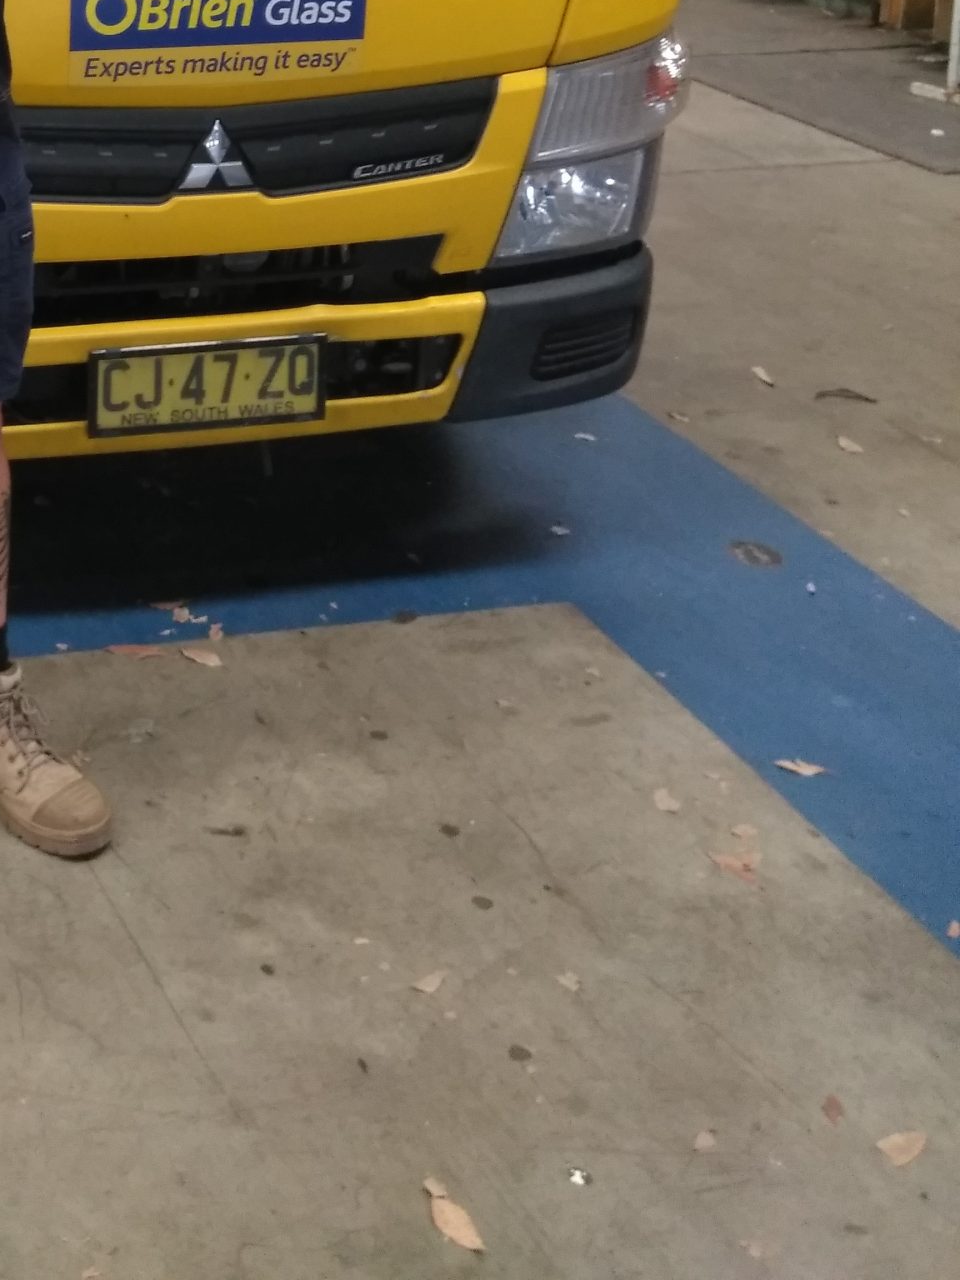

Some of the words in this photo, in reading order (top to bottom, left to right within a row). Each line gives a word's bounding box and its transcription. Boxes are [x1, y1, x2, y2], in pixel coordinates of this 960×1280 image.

[84, 55, 176, 82] Experts
[182, 52, 268, 76] making
[274, 49, 291, 70] it
[353, 154, 444, 179] CANTER
[120, 411, 159, 426] NEW
[170, 406, 229, 423] SOUTH
[239, 400, 295, 418] WALES
